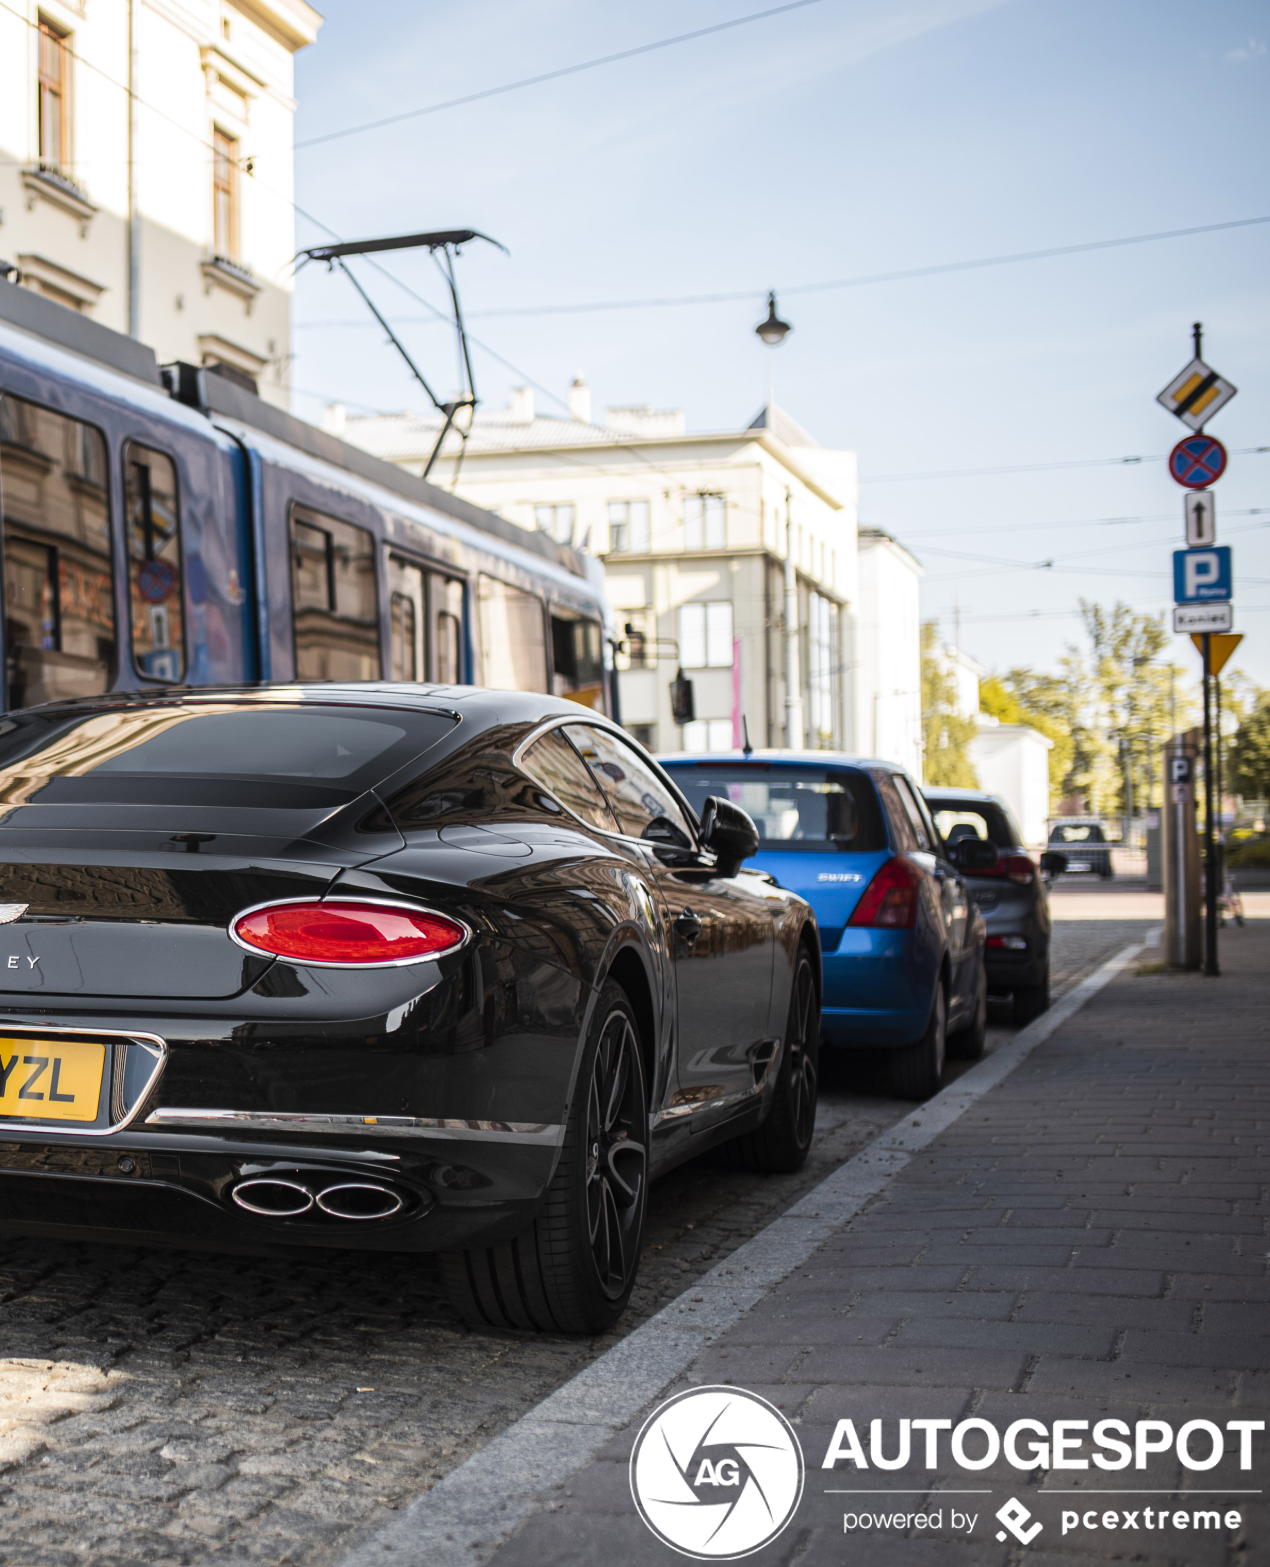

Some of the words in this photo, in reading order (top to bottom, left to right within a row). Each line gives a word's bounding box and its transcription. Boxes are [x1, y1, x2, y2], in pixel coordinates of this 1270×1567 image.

[1184, 552, 1220, 598] P
[1178, 613, 1227, 625] Koniec
[1172, 759, 1188, 782] P
[818, 873, 862, 882] SWIFT
